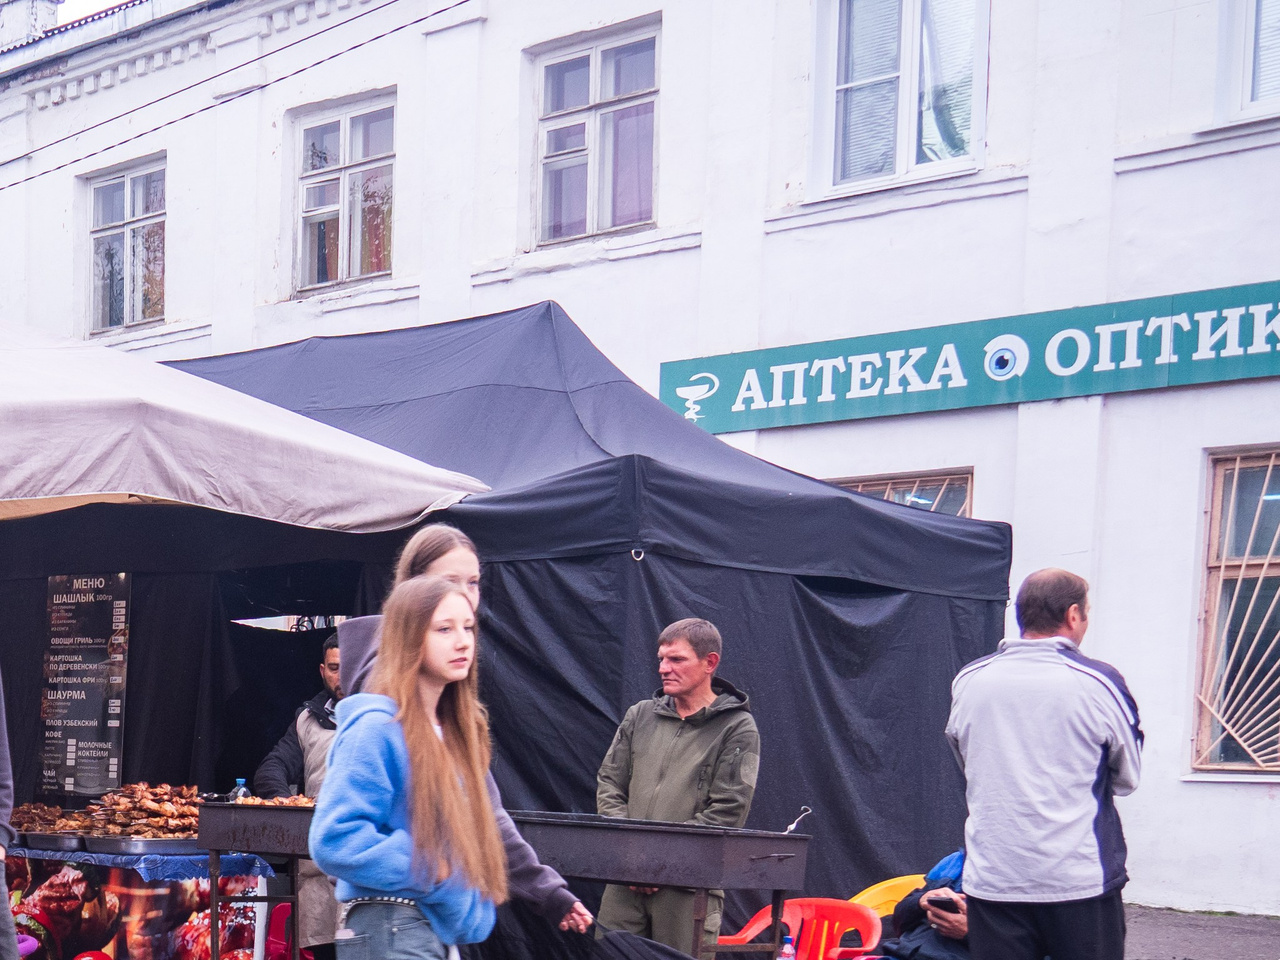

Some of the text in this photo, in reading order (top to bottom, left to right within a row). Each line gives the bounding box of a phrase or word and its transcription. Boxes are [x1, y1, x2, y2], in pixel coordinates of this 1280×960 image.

[731, 343, 968, 412] АПТЕКА
[73, 578, 105, 589] МЕНЮ
[53, 593, 95, 603] ШАШЛЫК
[51, 637, 73, 645] ОВОЩИ
[59, 663, 97, 671] ДЕРЕВЕНСКИ
[48, 676, 81, 684] КАРТОШКА
[47, 690, 86, 700] ШАУРМА
[63, 718, 98, 727] УЗБЕКСКИЙ
[78, 741, 112, 749] МОЛОЧНЫЕ
[77, 749, 109, 757] КОКТЕЙЛИ
[42, 769, 56, 777] ЧАЙ
